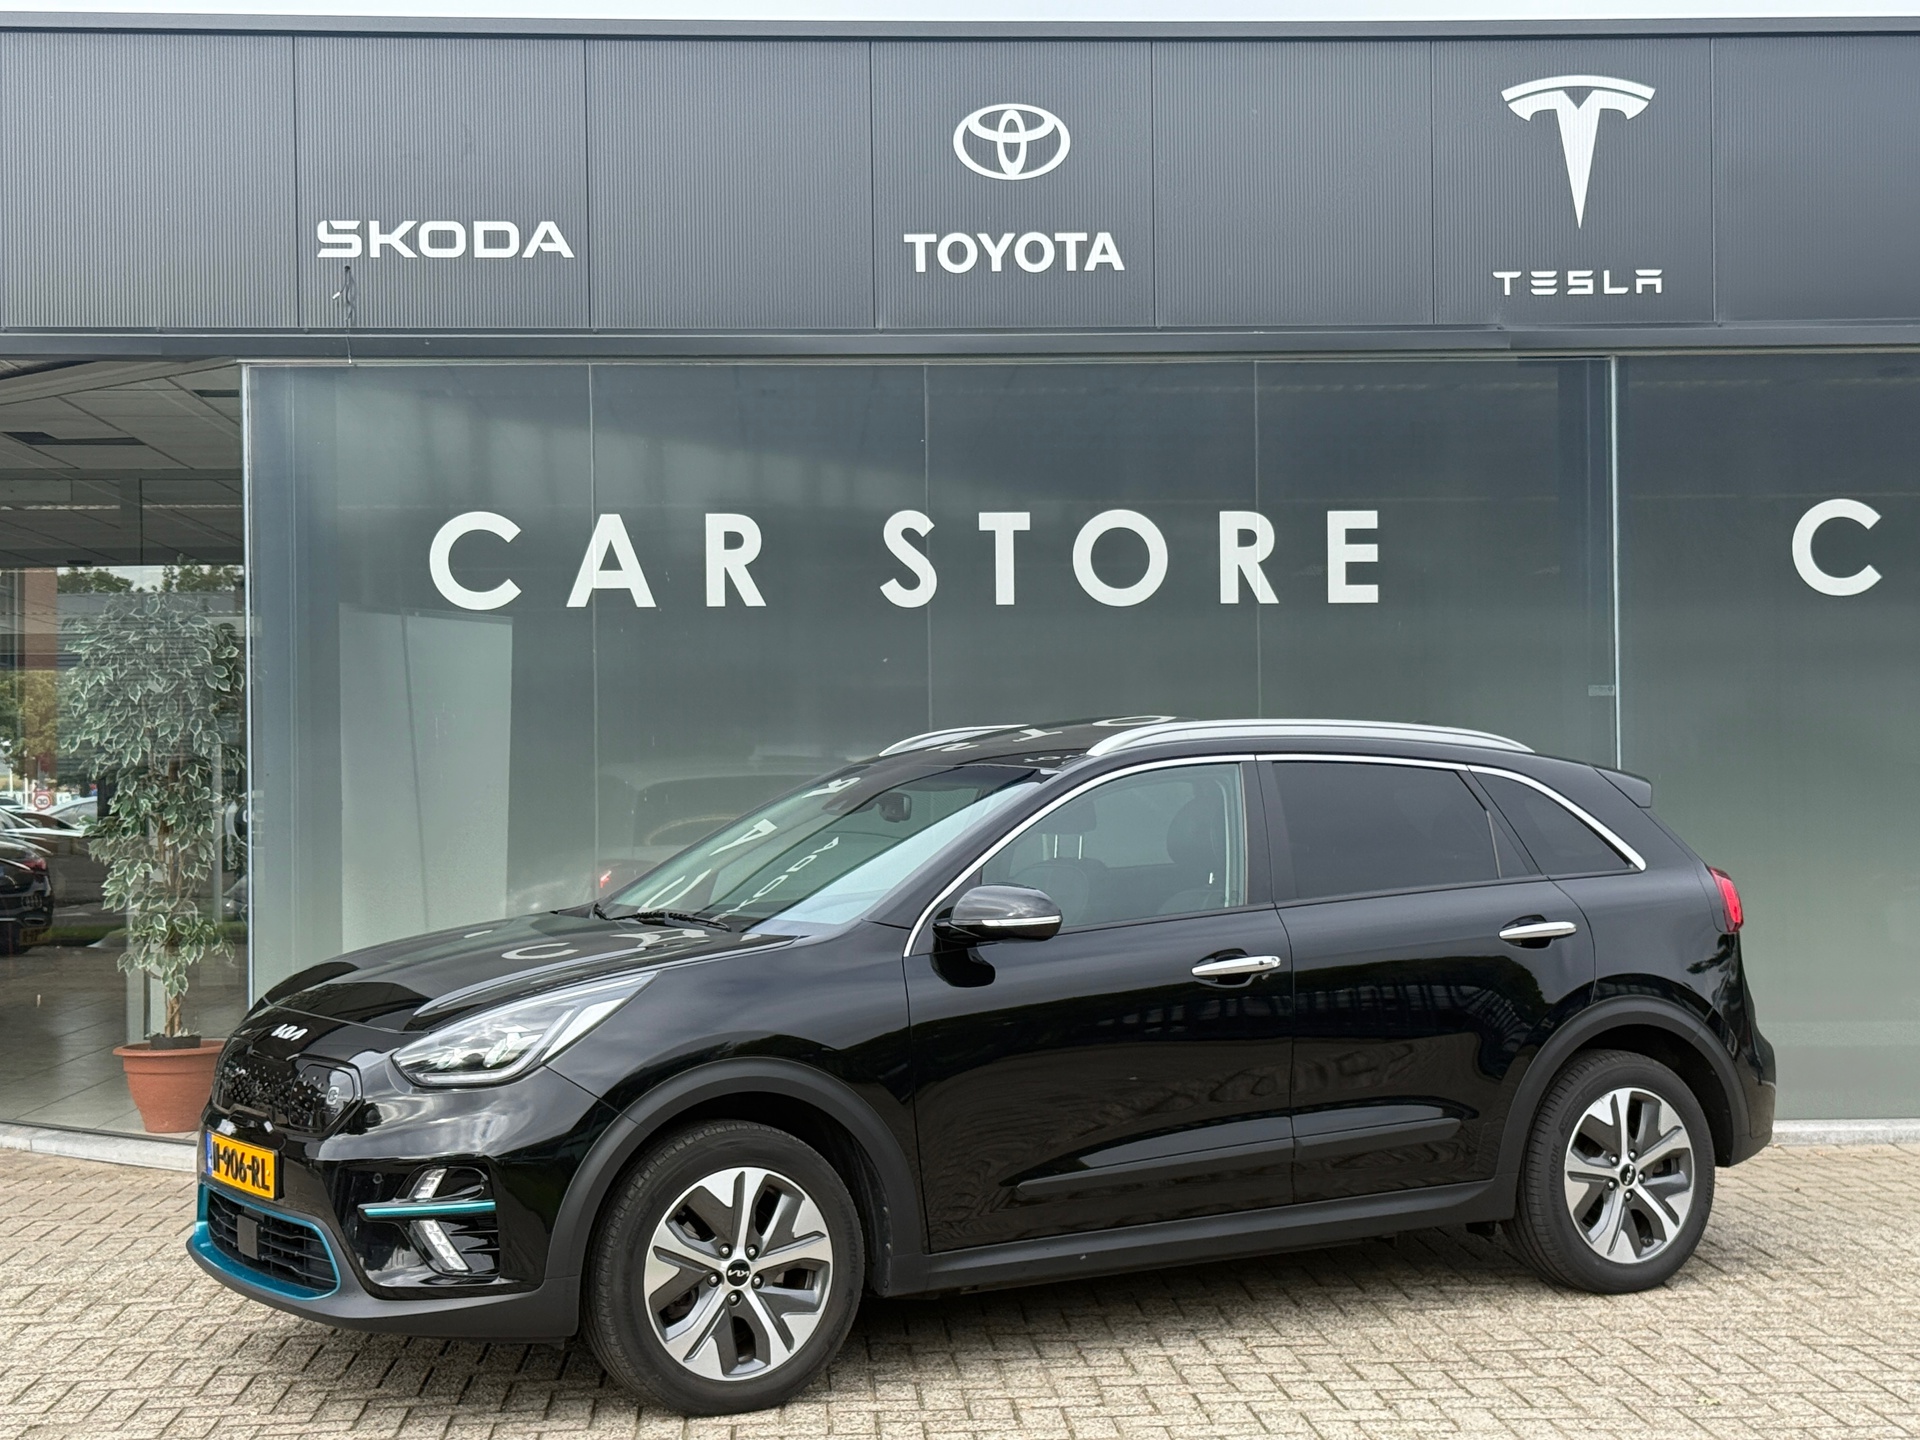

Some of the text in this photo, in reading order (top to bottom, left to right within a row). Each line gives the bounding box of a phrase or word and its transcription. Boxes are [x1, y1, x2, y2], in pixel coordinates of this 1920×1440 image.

[317, 220, 575, 259] SKODA
[903, 231, 1125, 274] TOYOTA
[1492, 268, 1663, 297] TESLA
[428, 508, 1380, 611] CAR STORE
[1791, 498, 1882, 597] C
